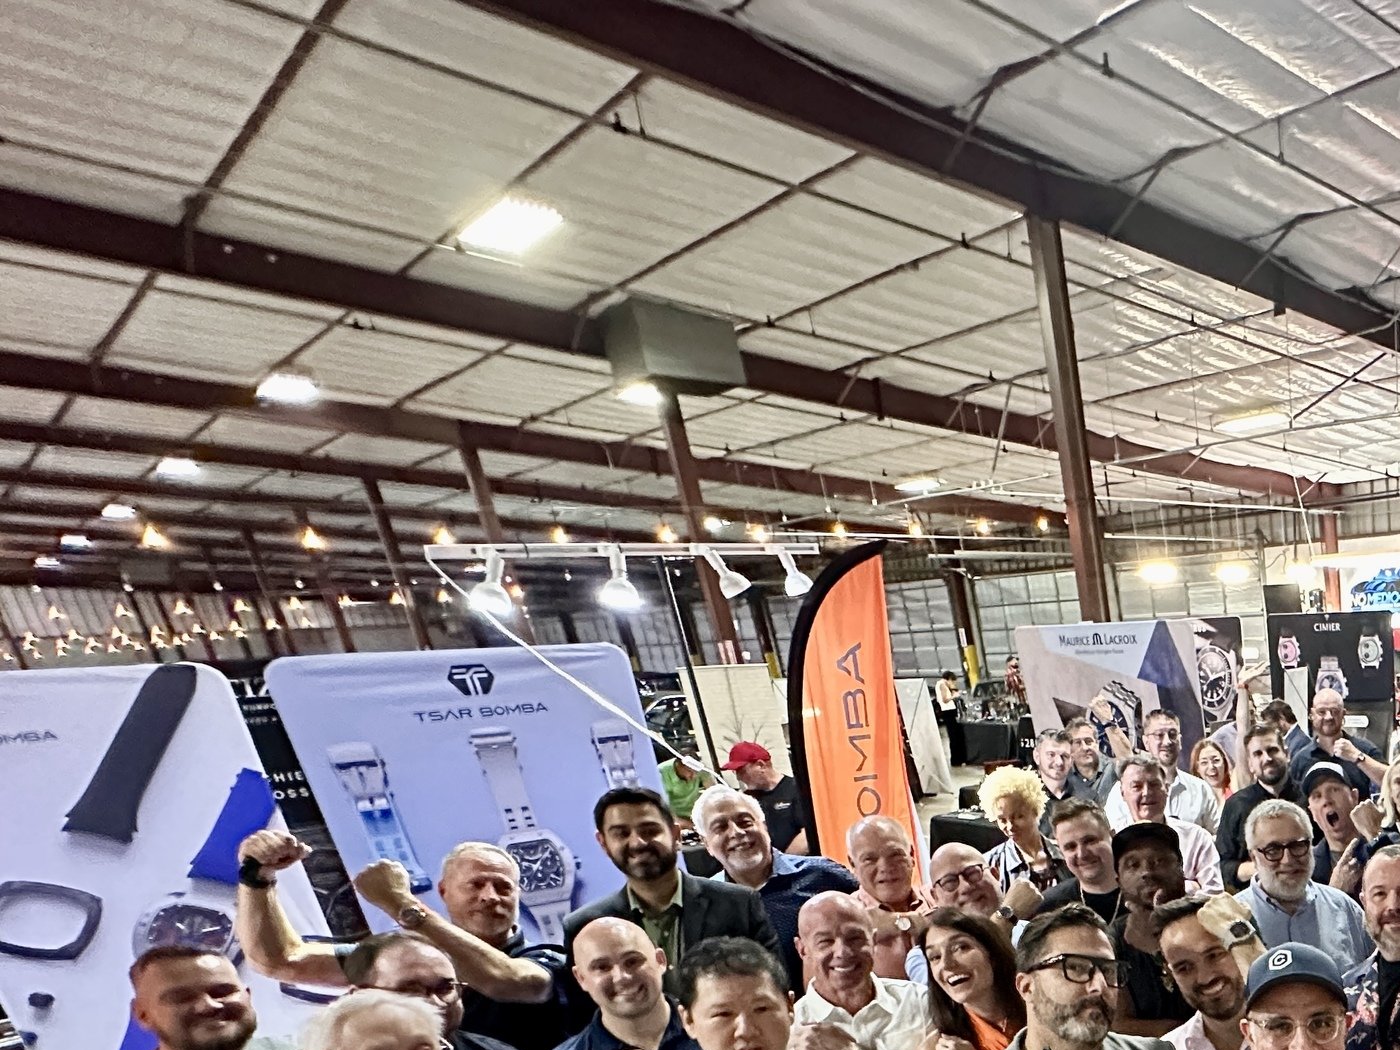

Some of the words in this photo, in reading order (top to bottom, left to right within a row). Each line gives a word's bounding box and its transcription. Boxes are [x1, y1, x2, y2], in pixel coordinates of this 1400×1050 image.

[1313, 622, 1341, 632] CIMIER
[1059, 634, 1091, 647] MAURICE
[1104, 632, 1138, 645] LACROIX
[413, 708, 473, 722] TSAR
[480, 702, 548, 717] BOMBA
